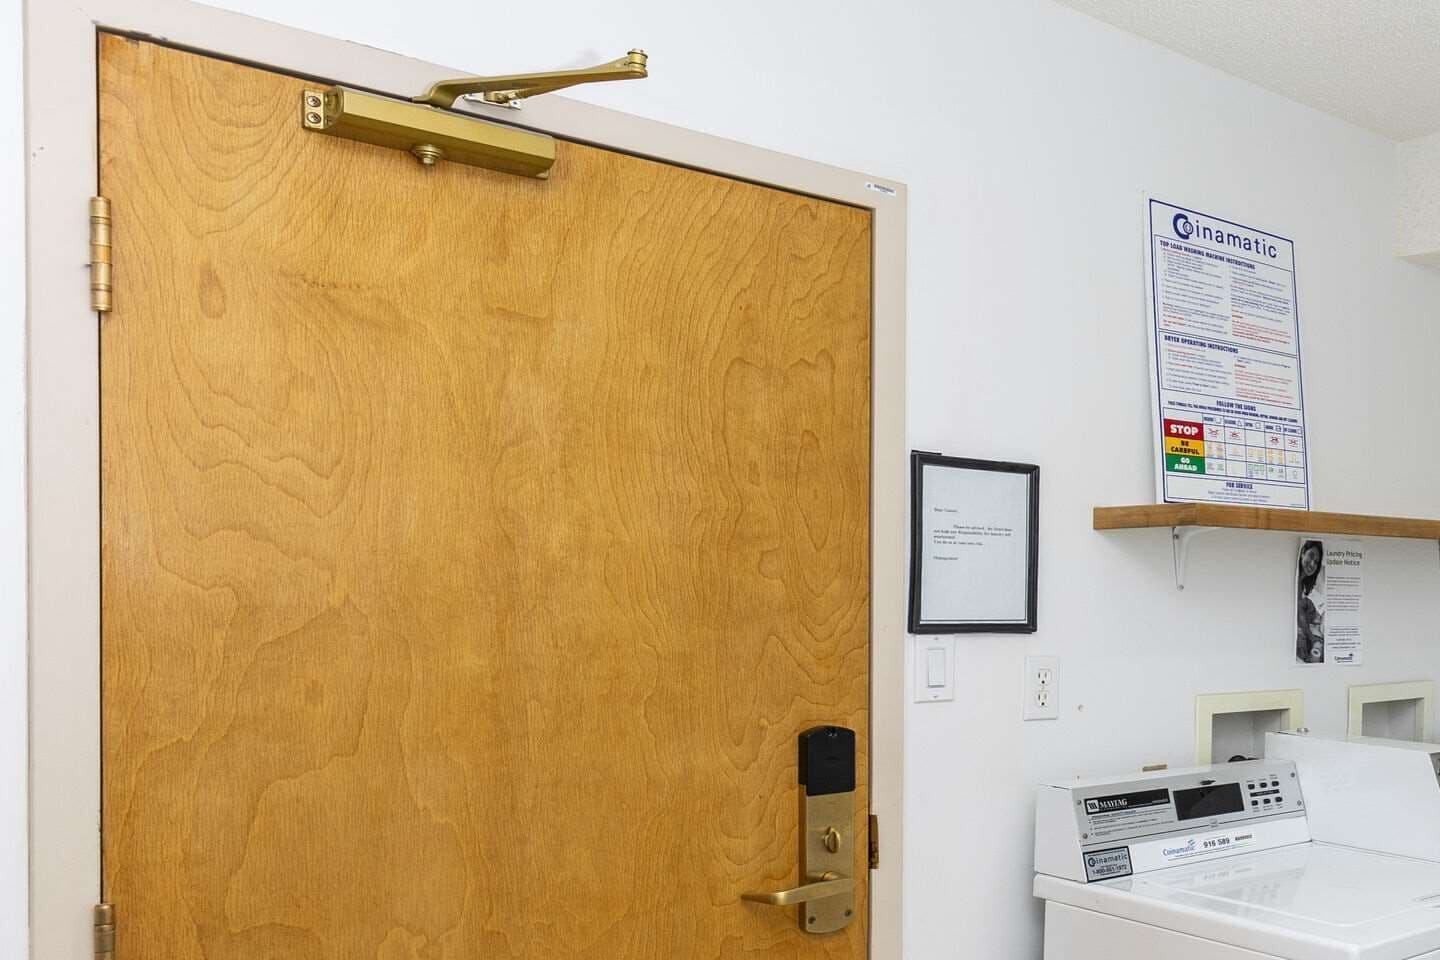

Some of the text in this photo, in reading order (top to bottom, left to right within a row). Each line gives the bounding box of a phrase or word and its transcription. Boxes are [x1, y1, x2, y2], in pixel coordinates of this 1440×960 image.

[1173, 213, 1277, 258] Coinamatic
[1170, 424, 1198, 436] STOP
[1171, 446, 1200, 455] CAREFUL
[1099, 799, 1128, 808] MAYTAG
[1088, 854, 1127, 867] Coinamatic
